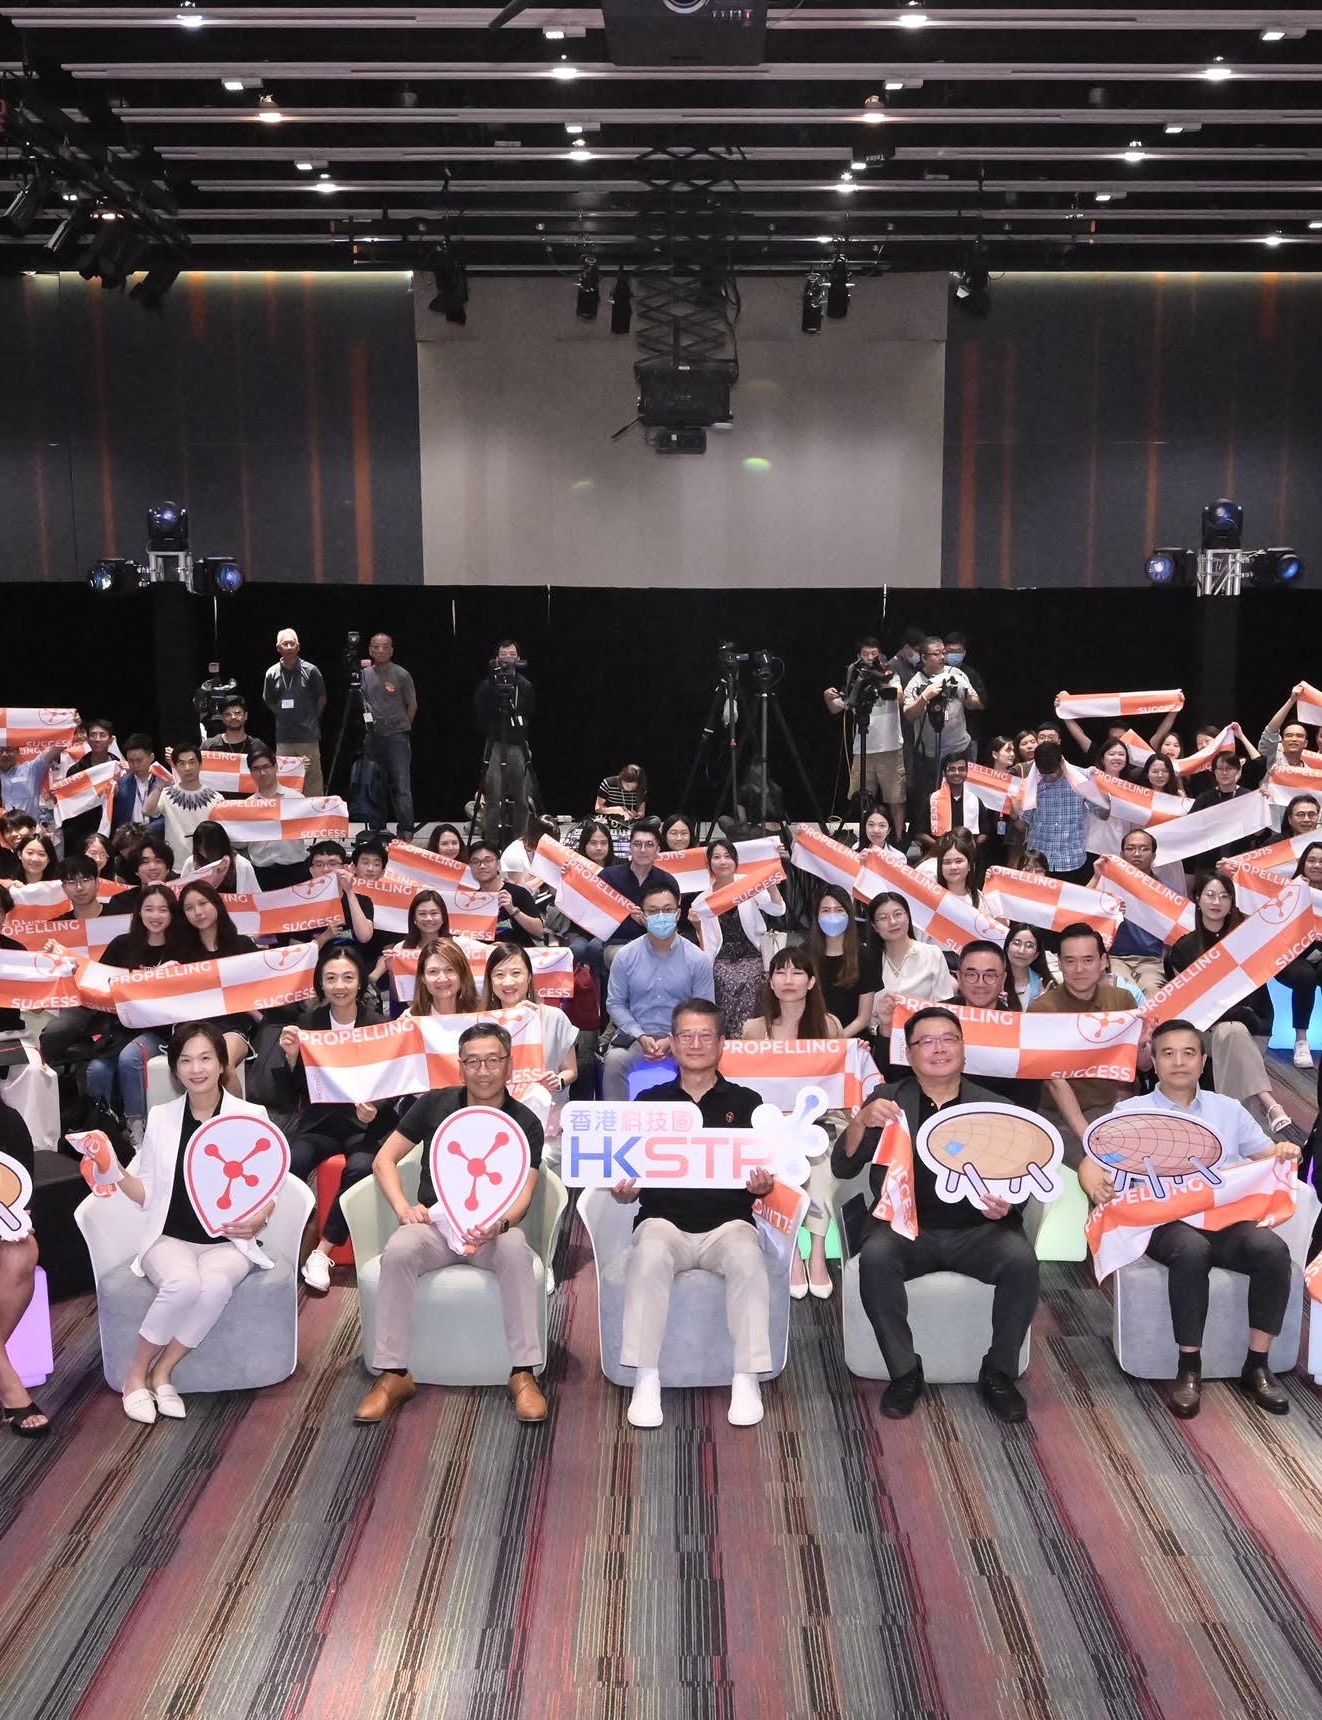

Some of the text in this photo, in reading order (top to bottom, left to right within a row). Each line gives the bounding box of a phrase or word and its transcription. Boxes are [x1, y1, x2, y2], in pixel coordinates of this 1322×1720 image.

[300, 829, 347, 838] SUCCESS
[390, 838, 462, 871] PROPELLING
[567, 859, 639, 914] PROPELLING
[732, 872, 783, 906] SUCCESS
[282, 913, 341, 931] SUCCESS
[110, 960, 213, 986] PROPELLING
[299, 1020, 415, 1048] PROPELLING
[570, 1136, 775, 1179] HKSTP
